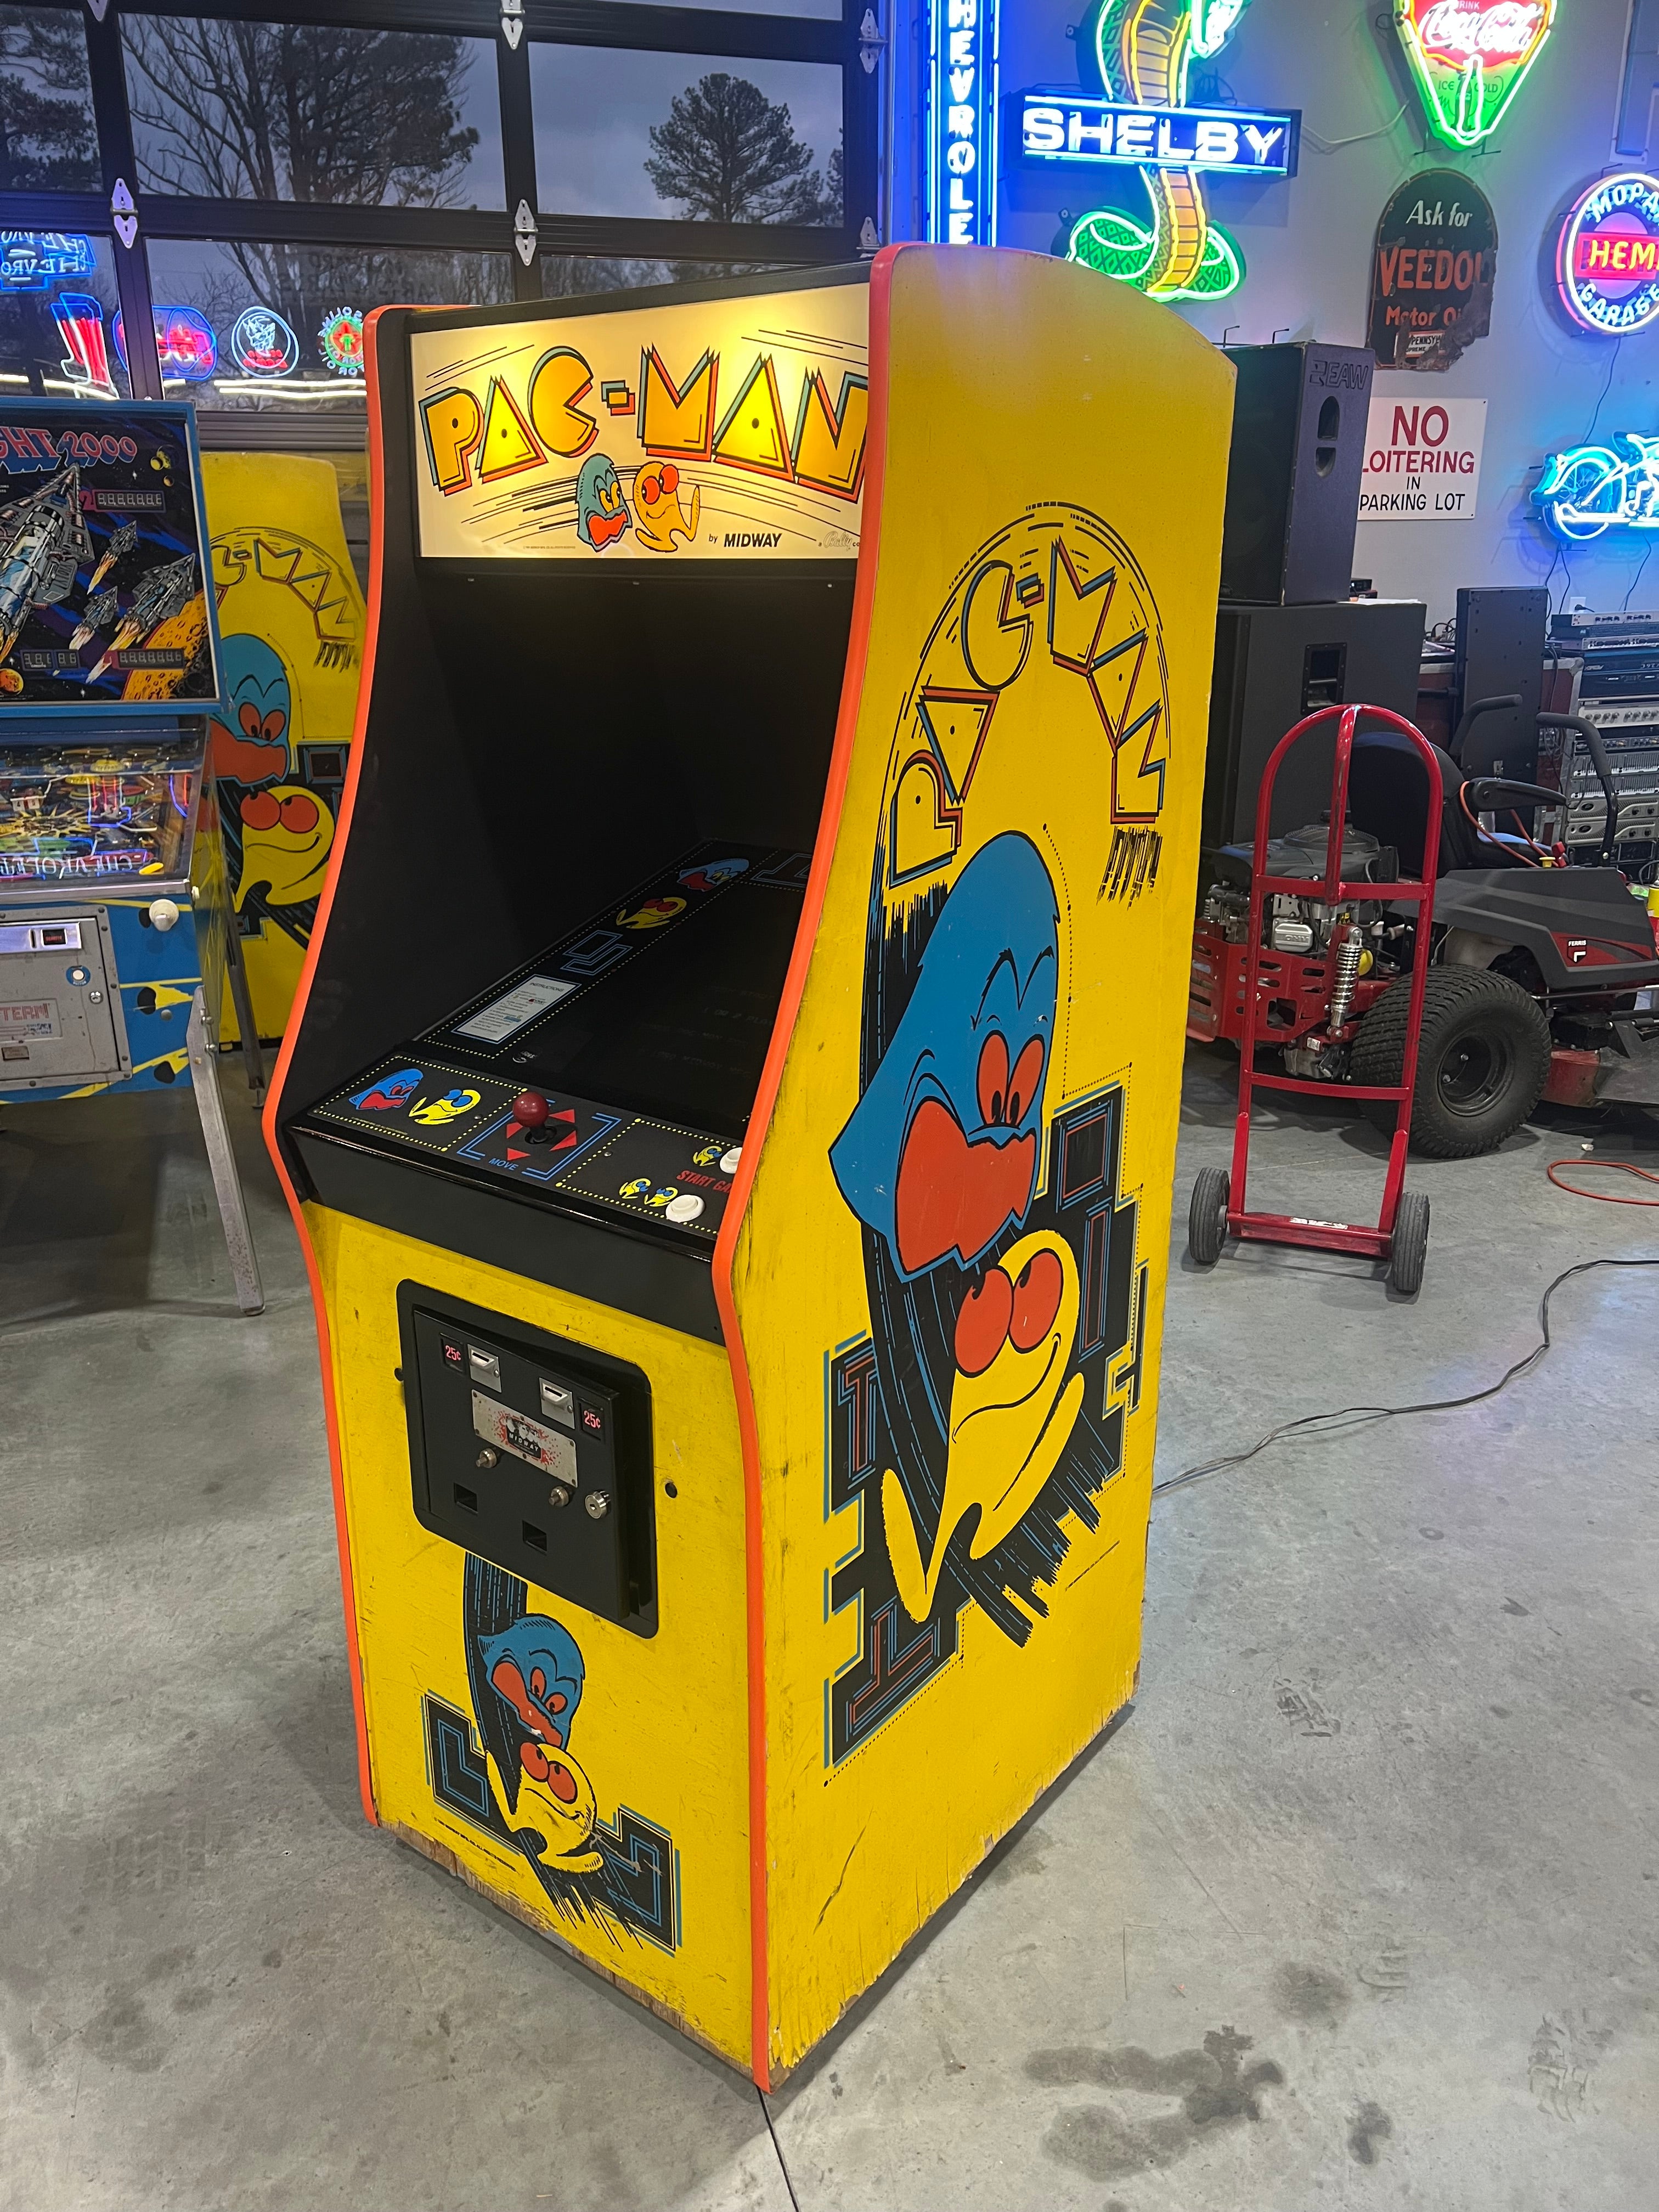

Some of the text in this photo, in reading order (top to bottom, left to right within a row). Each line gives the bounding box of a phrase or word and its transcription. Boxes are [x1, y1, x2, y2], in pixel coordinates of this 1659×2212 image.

[1438, 81, 1454, 90] ICE
[1023, 108, 1283, 165] SHELBY
[1406, 200, 1473, 227] Ask for
[1589, 239, 1659, 270] HEM
[1386, 305, 1437, 326] Motor
[1325, 362, 1369, 390] EAW
[418, 341, 870, 503] PAC-MAN
[1391, 405, 1449, 447] NO
[61, 431, 138, 462] 2000
[1407, 476, 1420, 490] IN
[1359, 493, 1465, 511] PARKING LOT
[709, 534, 718, 544] by
[724, 533, 782, 548] MIDWAY
[823, 531, 853, 551] Bally
[889, 535, 1166, 889] PAC-MAN
[488, 1158, 519, 1171] MOVE
[676, 1170, 716, 1188] START
[509, 1432, 539, 1452] MIDWAY
